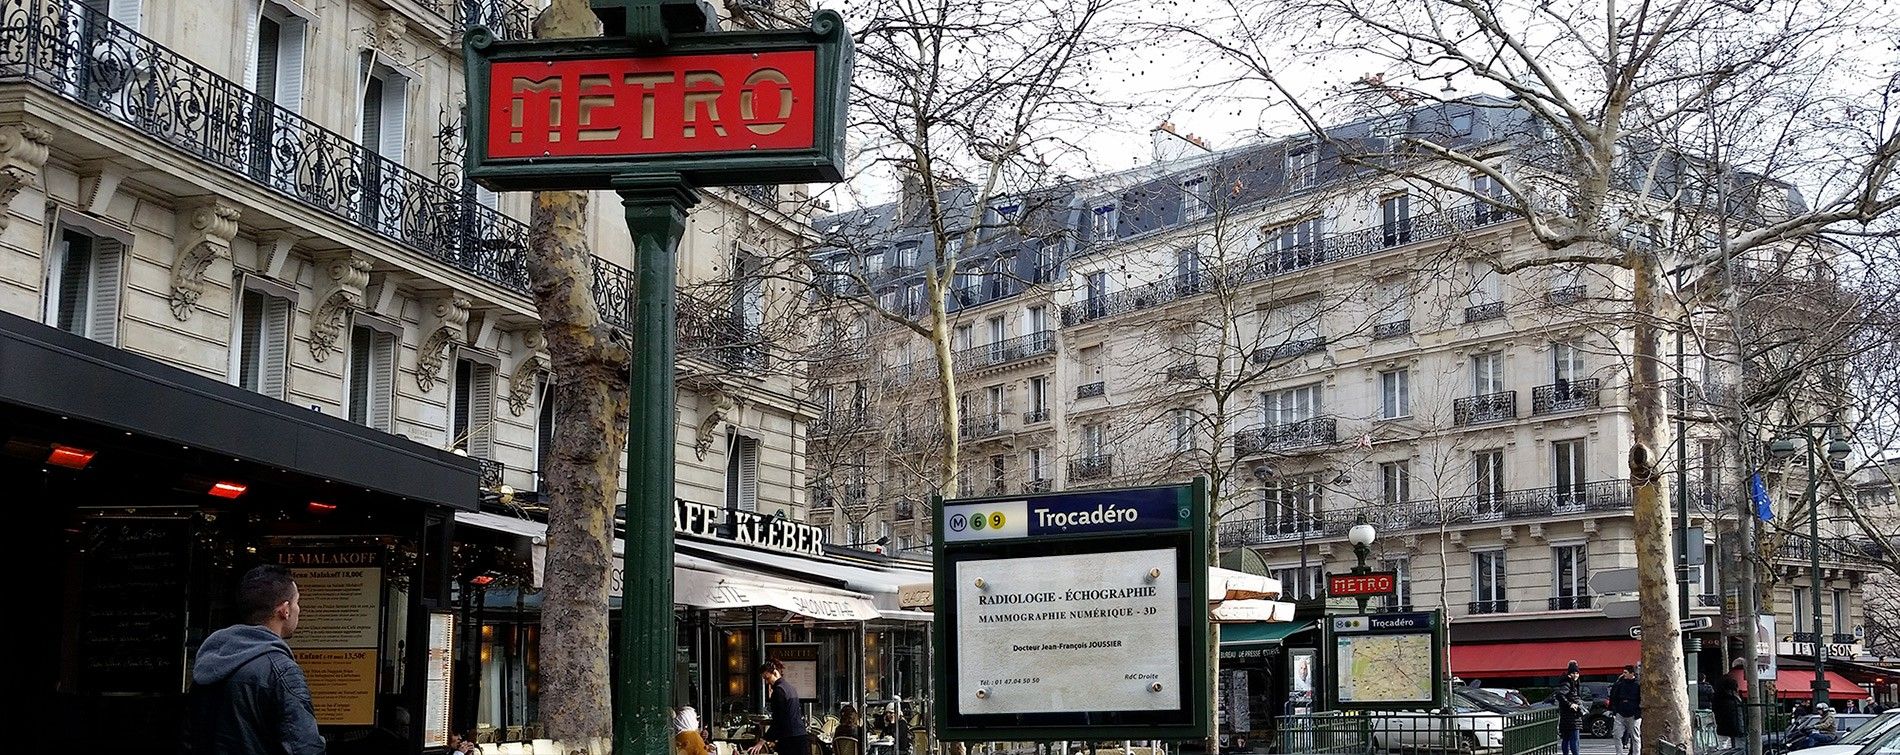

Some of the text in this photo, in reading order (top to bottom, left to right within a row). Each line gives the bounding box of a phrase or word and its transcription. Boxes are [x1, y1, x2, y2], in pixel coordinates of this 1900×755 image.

[510, 67, 794, 144] METRO
[974, 516, 982, 527] 6
[993, 514, 1000, 526] 9
[1034, 503, 1138, 528] Trocadéro
[278, 552, 377, 564] LE MALAKOFF
[1334, 577, 1389, 593] METRO
[978, 591, 1056, 606] RADIOLOGIE
[1065, 586, 1157, 602] ÉCHOGRAPHIE
[978, 610, 1067, 624] MAMMOGRAPHIE
[1069, 606, 1134, 619] NUMÉRIQUE
[1143, 606, 1157, 616] 3D
[1371, 618, 1414, 628] Trocadéro
[1012, 640, 1122, 652] Docteur Jean-François JOUSSIER
[1138, 672, 1159, 680] Droite
